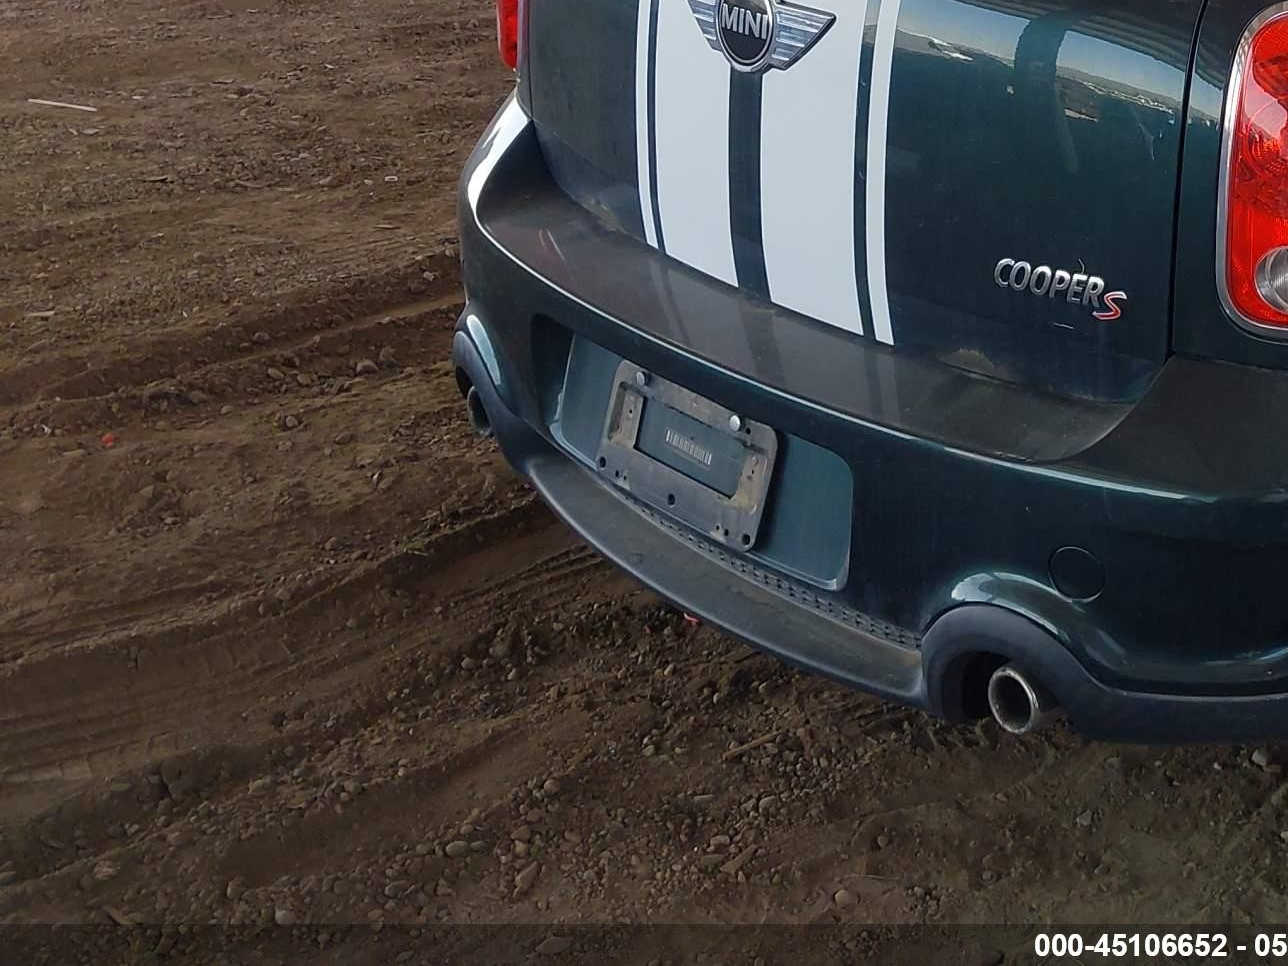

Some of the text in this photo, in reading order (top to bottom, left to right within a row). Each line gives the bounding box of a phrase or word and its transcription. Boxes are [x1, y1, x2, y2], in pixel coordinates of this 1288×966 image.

[721, 3, 769, 40] MINI
[993, 258, 1128, 320] COOPER S
